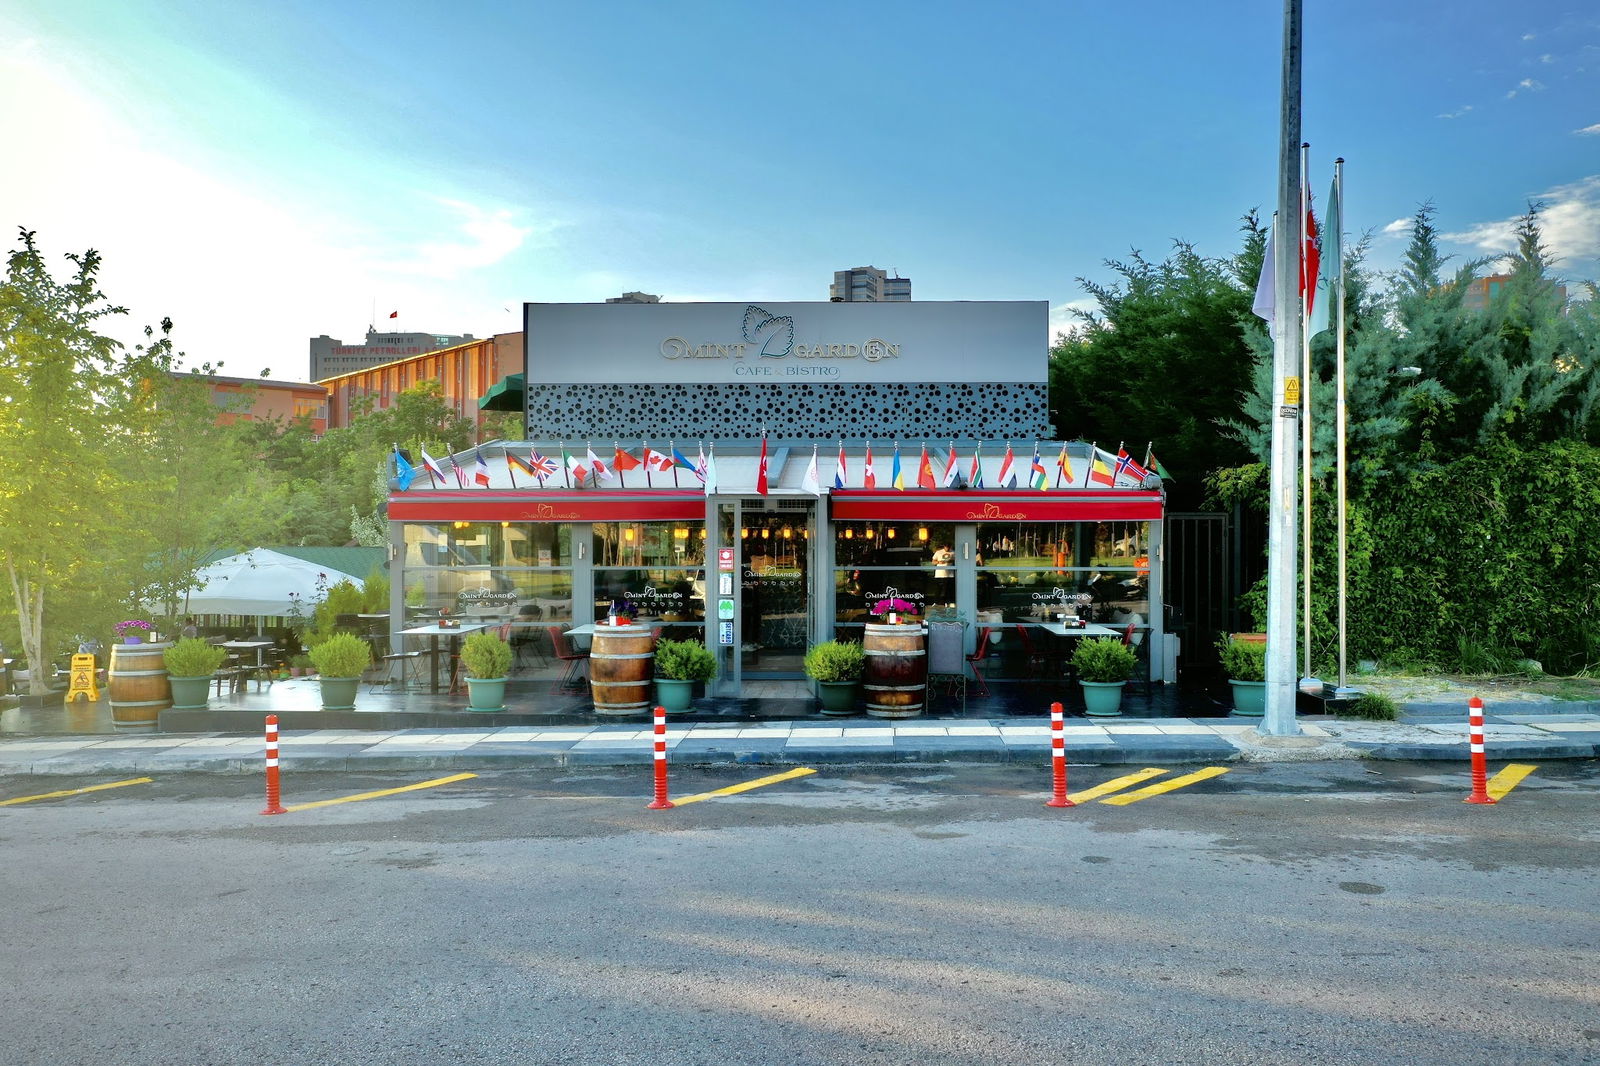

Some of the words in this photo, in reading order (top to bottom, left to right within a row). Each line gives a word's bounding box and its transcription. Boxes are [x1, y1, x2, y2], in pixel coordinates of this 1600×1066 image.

[793, 338, 900, 362] GARDEN
[733, 361, 772, 376] CAFE
[655, 592, 683, 600] GARDEN
[897, 592, 925, 600] GARDEN
